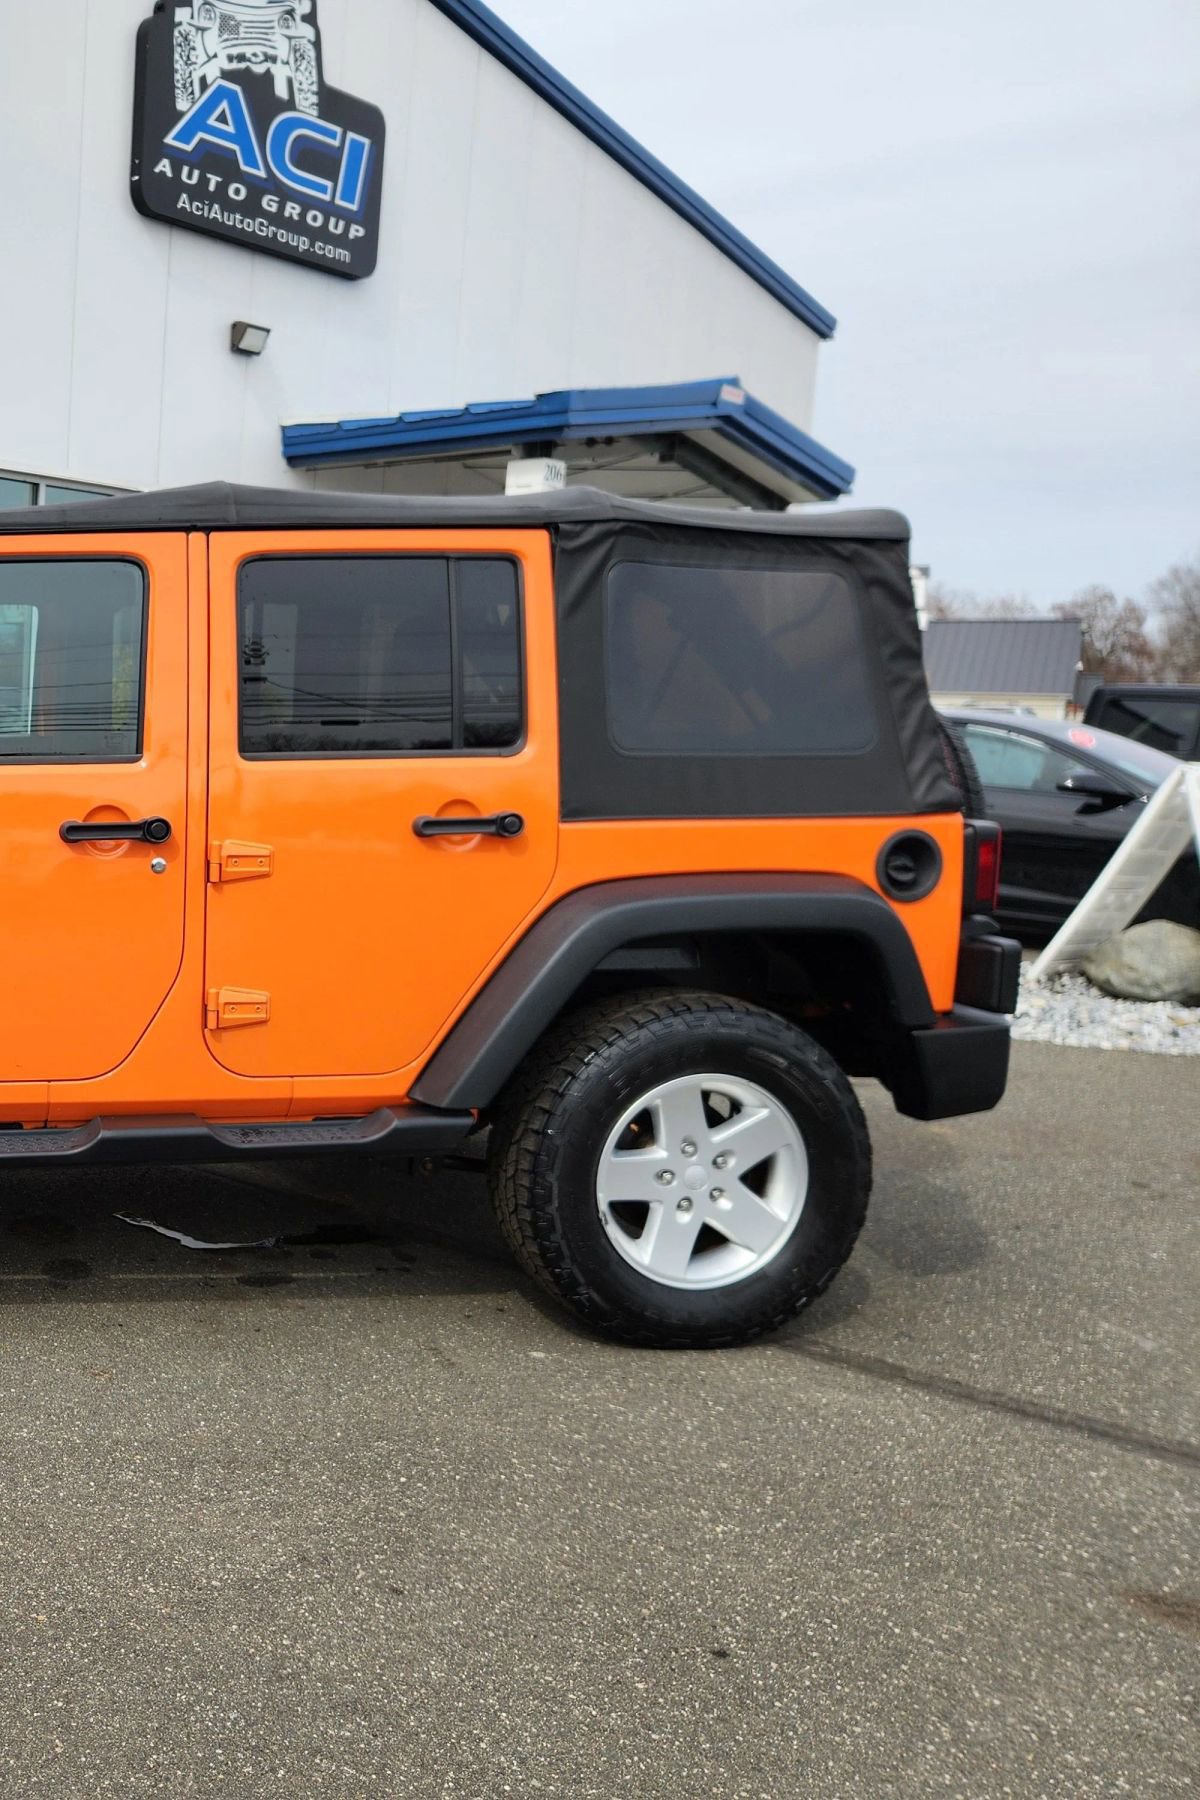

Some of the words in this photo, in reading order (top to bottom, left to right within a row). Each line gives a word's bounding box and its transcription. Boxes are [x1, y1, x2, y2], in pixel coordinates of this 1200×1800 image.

[162, 77, 371, 212] ACI
[153, 157, 248, 202] AUTO
[261, 193, 366, 240] GROUP
[176, 192, 351, 264] AciAutoGroup.com
